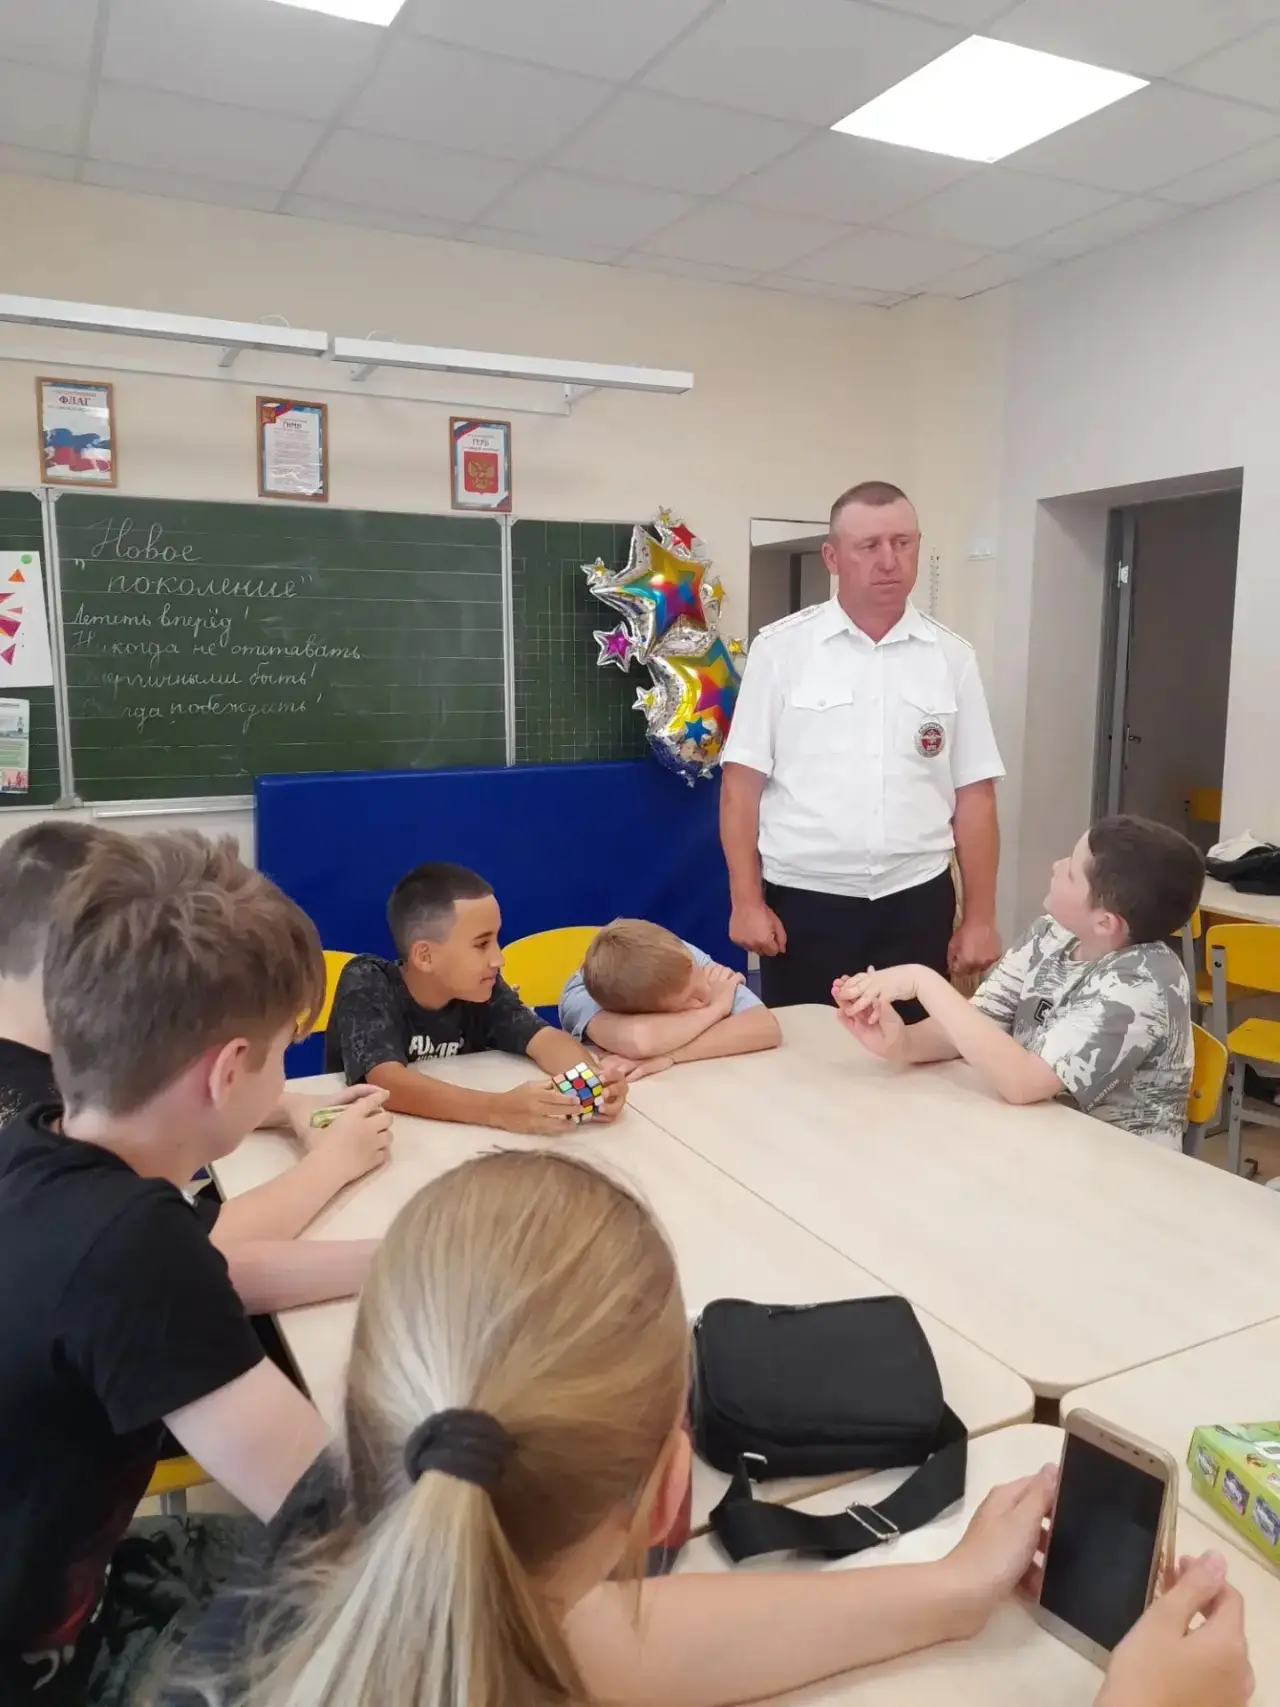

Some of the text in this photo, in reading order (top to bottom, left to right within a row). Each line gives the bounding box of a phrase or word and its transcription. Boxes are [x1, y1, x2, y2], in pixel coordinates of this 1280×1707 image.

[58, 395, 91, 405] ФЛАГ
[472, 438, 490, 447] ГЕРБ
[193, 643, 218, 656] не
